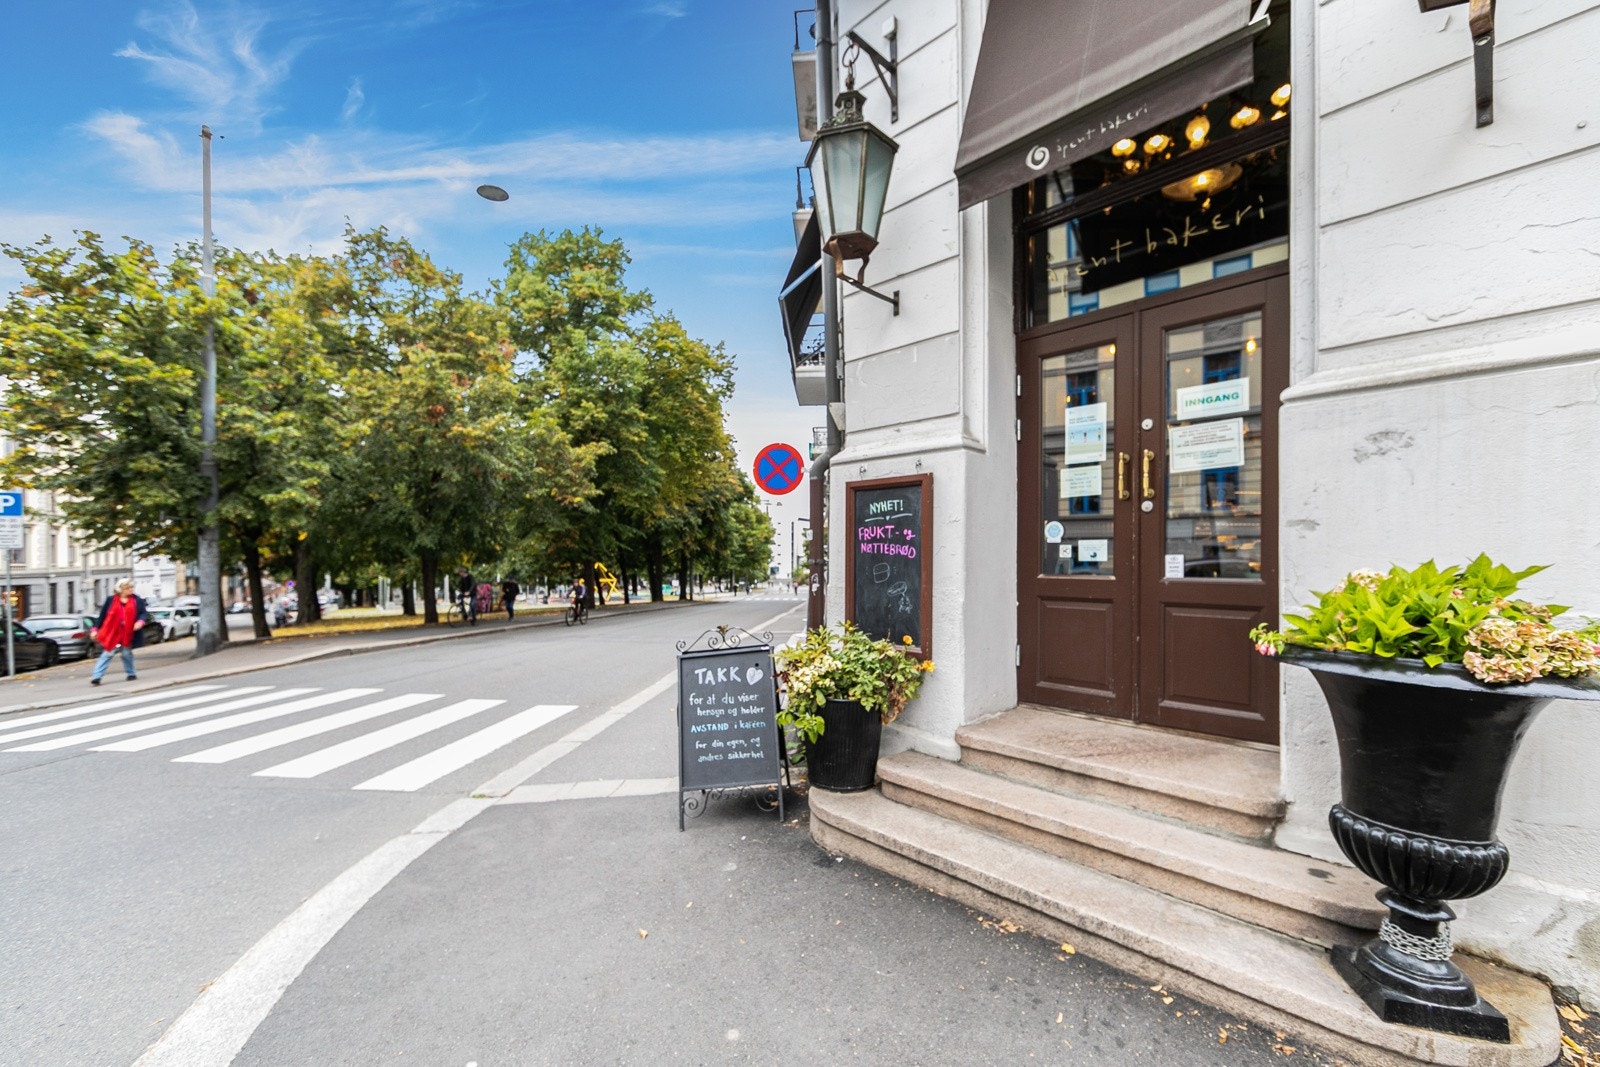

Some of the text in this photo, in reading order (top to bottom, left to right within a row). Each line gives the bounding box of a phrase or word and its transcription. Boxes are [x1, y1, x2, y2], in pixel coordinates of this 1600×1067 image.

[1100, 102, 1148, 133] bakeri
[1146, 194, 1265, 254] bakeri
[1184, 391, 1240, 408] INNGANG
[0, 494, 16, 514] P
[869, 499, 904, 515] NYHET!
[860, 542, 917, 559] NØTTEBRØD
[694, 666, 742, 686] TAKK
[689, 692, 759, 706] for at du viser
[697, 705, 766, 718] hensyn og holder
[690, 722, 729, 733] AVSTAND
[695, 740, 708, 749] for
[711, 739, 724, 748] din
[750, 737, 761, 747] og
[697, 750, 764, 763] andres sikkerhet
